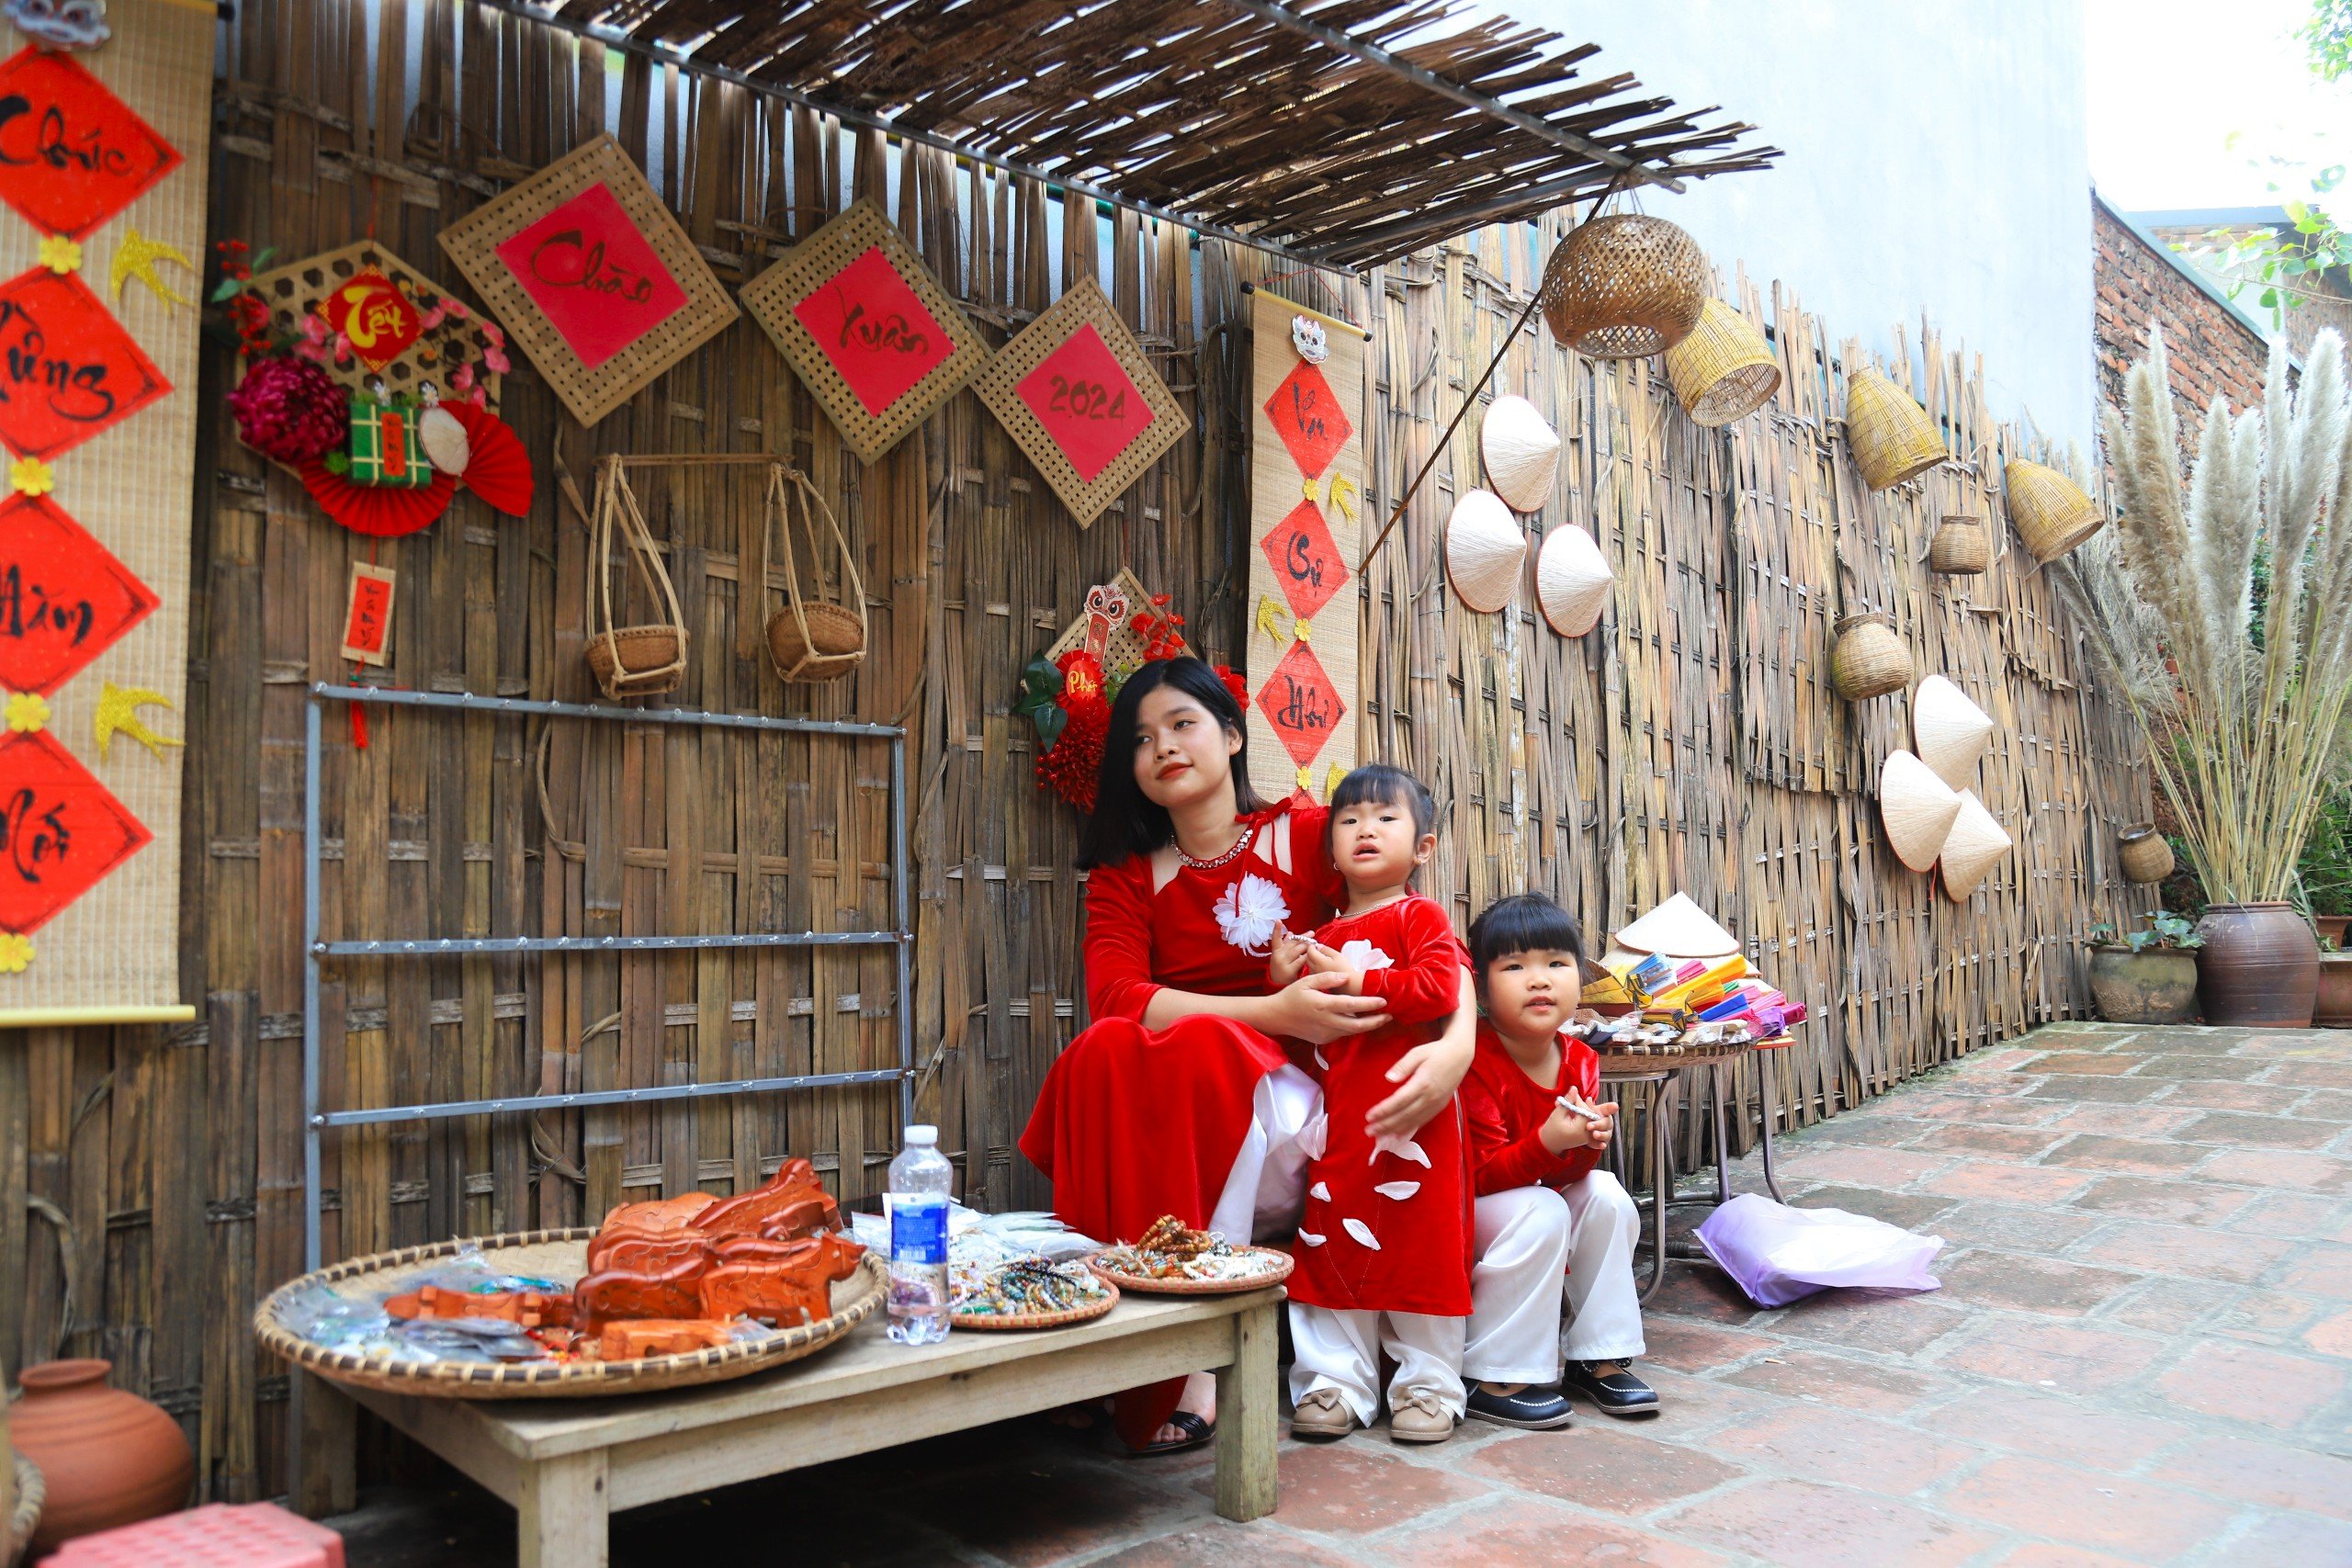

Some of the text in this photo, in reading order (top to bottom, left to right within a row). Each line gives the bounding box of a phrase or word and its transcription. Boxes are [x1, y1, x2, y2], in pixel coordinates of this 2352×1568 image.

[0, 95, 134, 176] Chúc
[834, 285, 930, 356] Xuân
[1049, 375, 1125, 428] 2024
